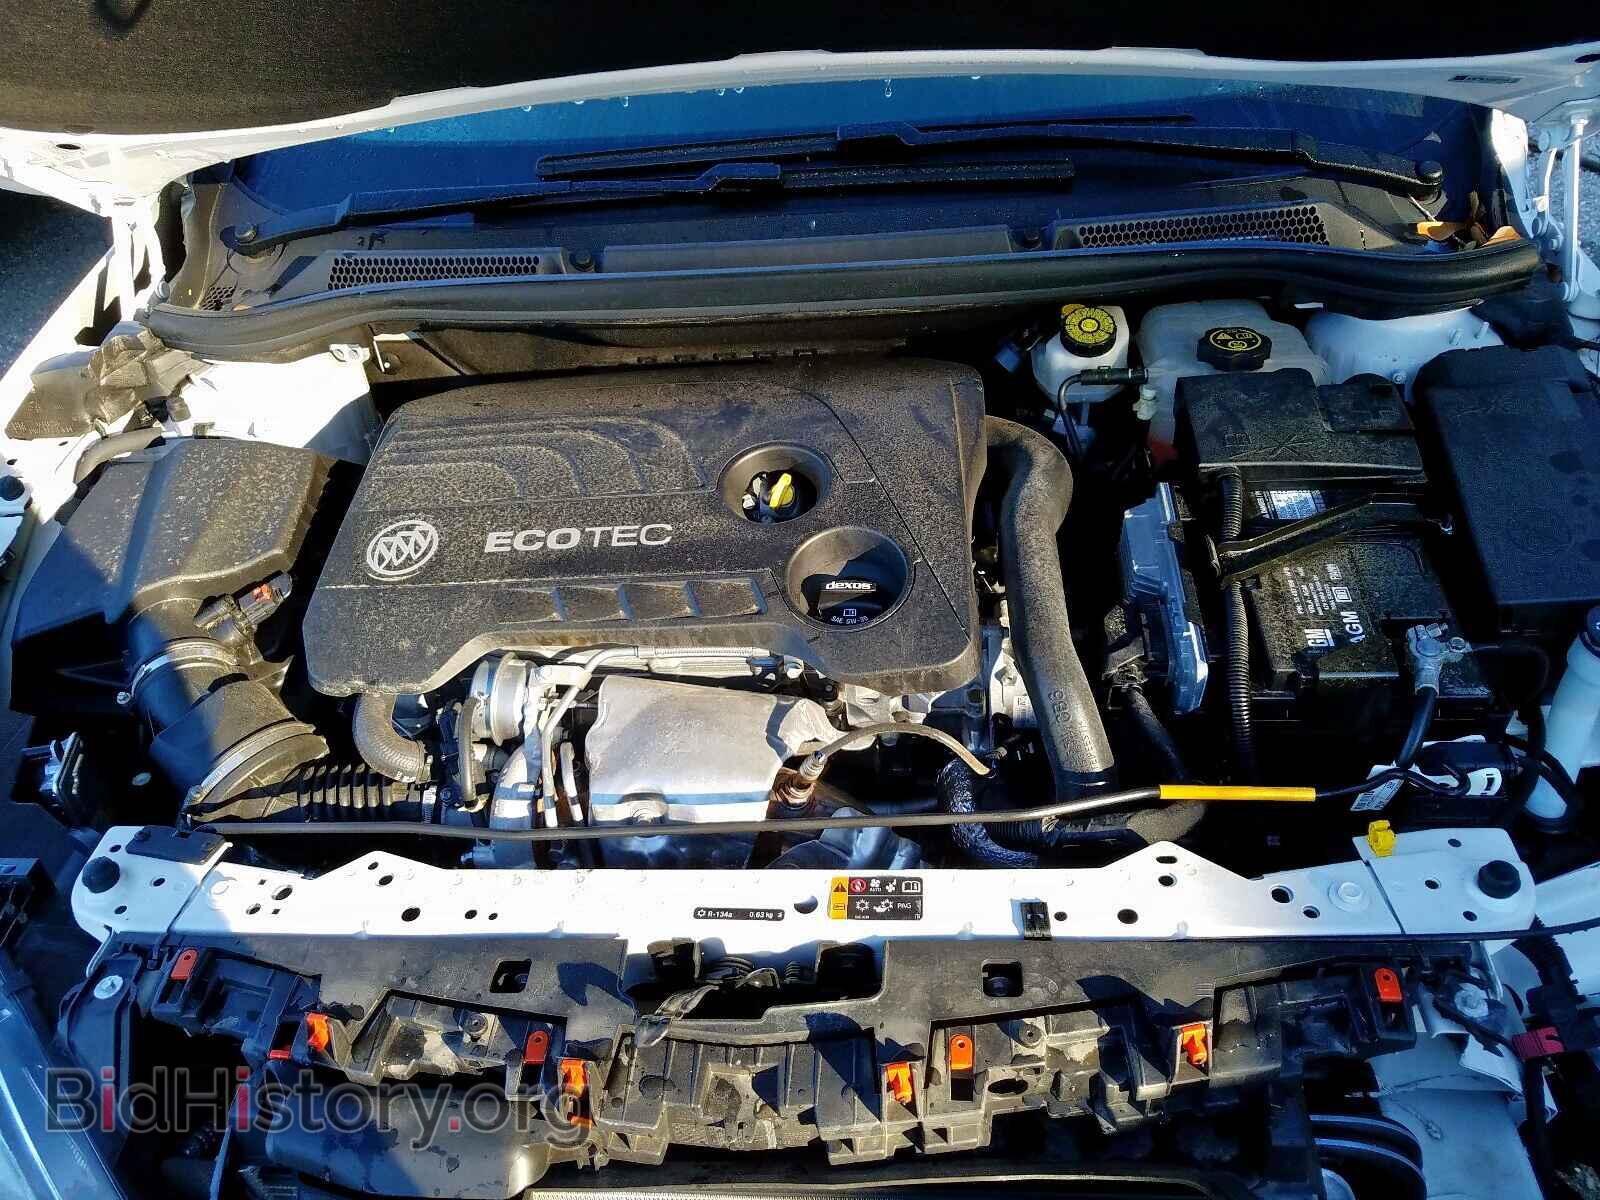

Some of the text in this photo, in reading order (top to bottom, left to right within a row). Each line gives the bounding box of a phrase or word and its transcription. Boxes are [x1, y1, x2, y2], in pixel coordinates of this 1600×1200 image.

[484, 523, 673, 553] ECOTEC
[825, 581, 873, 590] dexos
[1340, 610, 1366, 644] AGM
[1303, 628, 1329, 647] GM
[707, 910, 733, 919] R-134a
